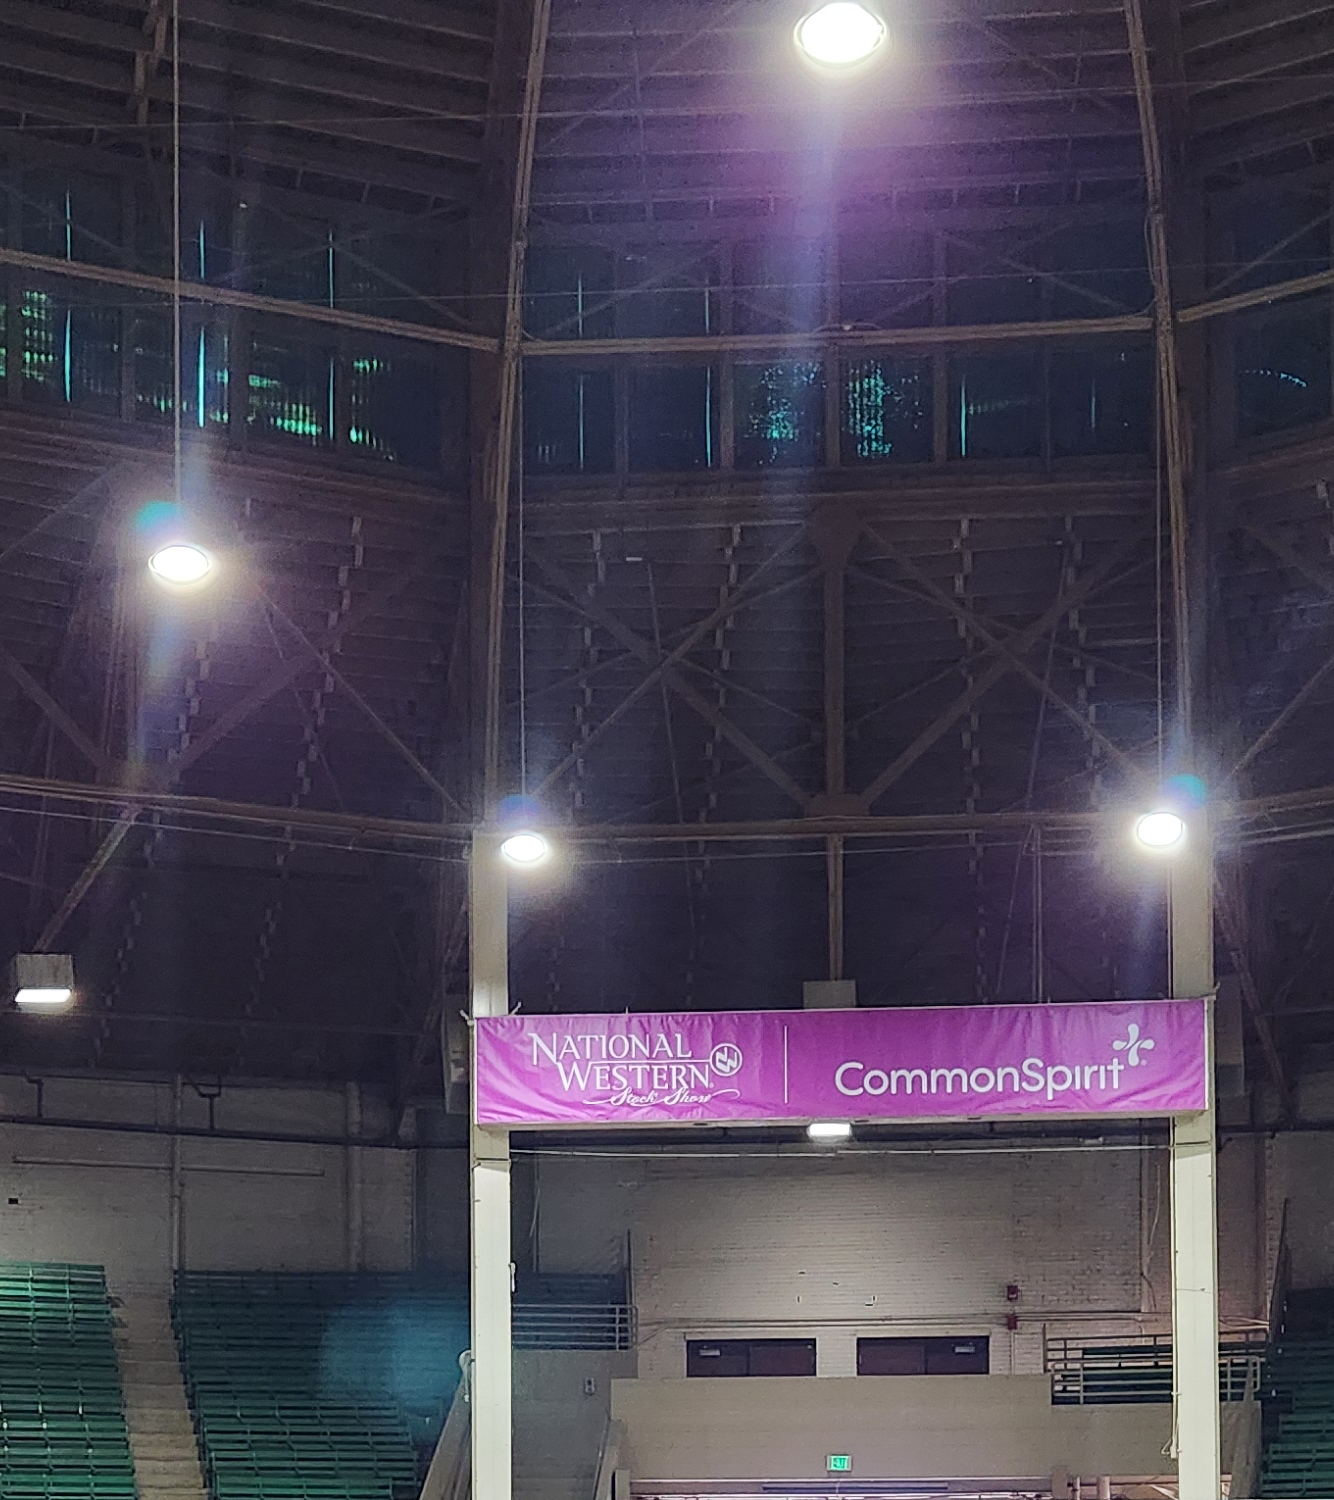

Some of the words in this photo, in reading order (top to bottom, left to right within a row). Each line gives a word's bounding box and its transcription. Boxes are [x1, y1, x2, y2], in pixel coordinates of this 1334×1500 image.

[528, 1032, 693, 1066] NATIONAL
[556, 1062, 710, 1091] WESTERN
[834, 1057, 1125, 1101] CommonSpirit
[601, 1087, 657, 1106] Stock
